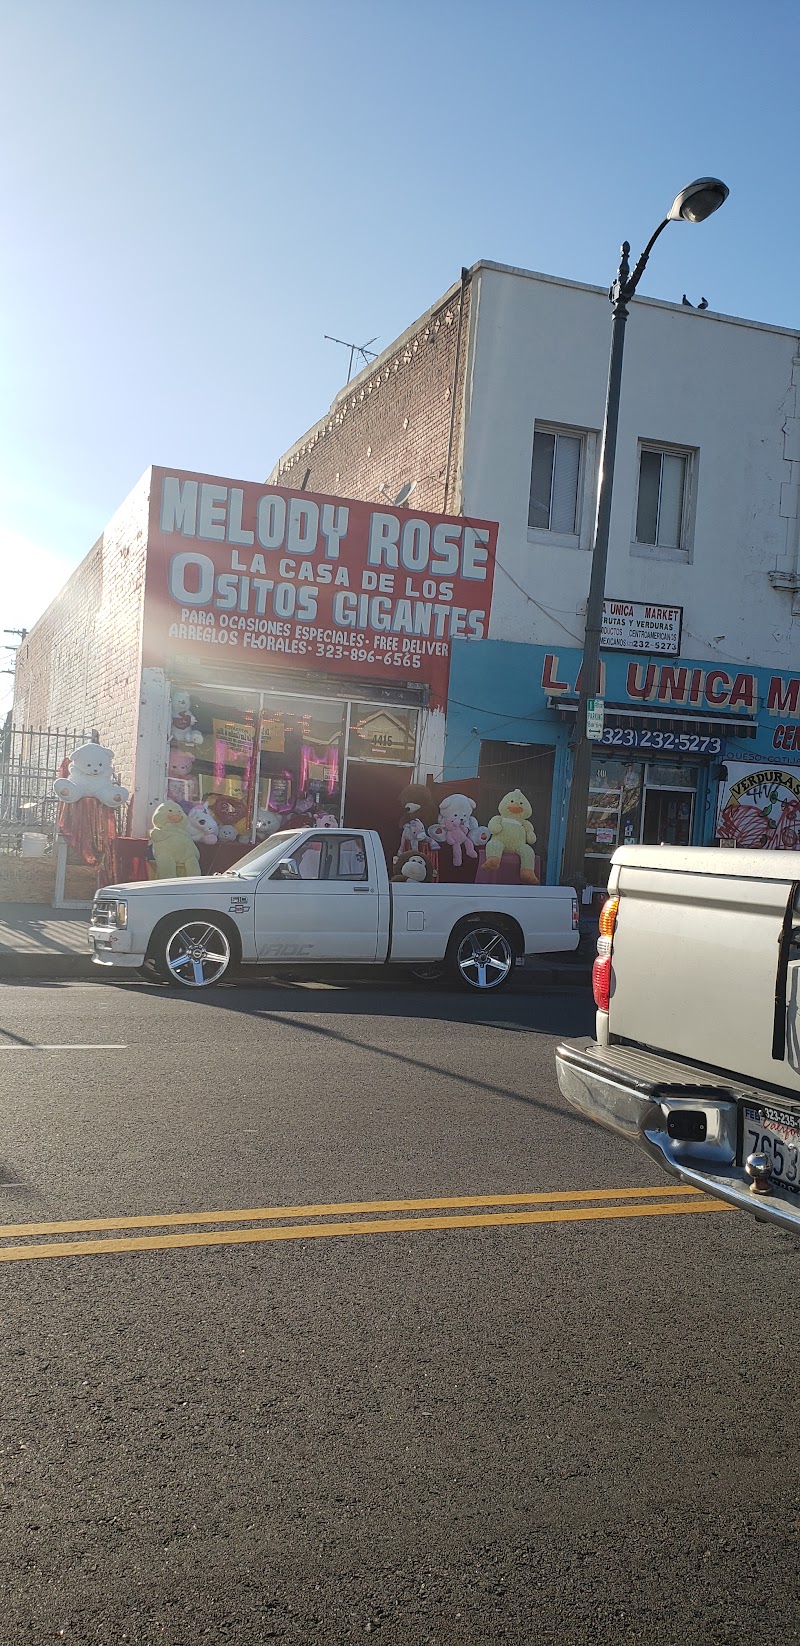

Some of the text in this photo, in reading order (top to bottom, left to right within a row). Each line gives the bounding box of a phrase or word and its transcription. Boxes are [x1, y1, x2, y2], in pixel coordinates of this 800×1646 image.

[160, 477, 490, 582] MELODY ROSE
[231, 550, 454, 601] LA CASA DE LOS
[168, 552, 486, 641] OSITOS GIGANTES
[610, 603, 634, 617] UNICA
[644, 607, 679, 621] MARKET
[181, 608, 215, 625] PARA
[219, 614, 292, 637] OCASIONES
[373, 635, 399, 651] FREE
[402, 638, 449, 656] DELIVER
[629, 619, 634, 627] Y
[636, 620, 673, 631] VERDURAS
[168, 623, 239, 646] ARREGLOS
[315, 642, 421, 669] 323-896-6565
[633, 640, 677, 650] 232-5273
[626, 662, 758, 714] UNICA
[372, 734, 392, 746] 4415
[732, 771, 800, 796] VERDURAS
[259, 944, 314, 956] IROC
